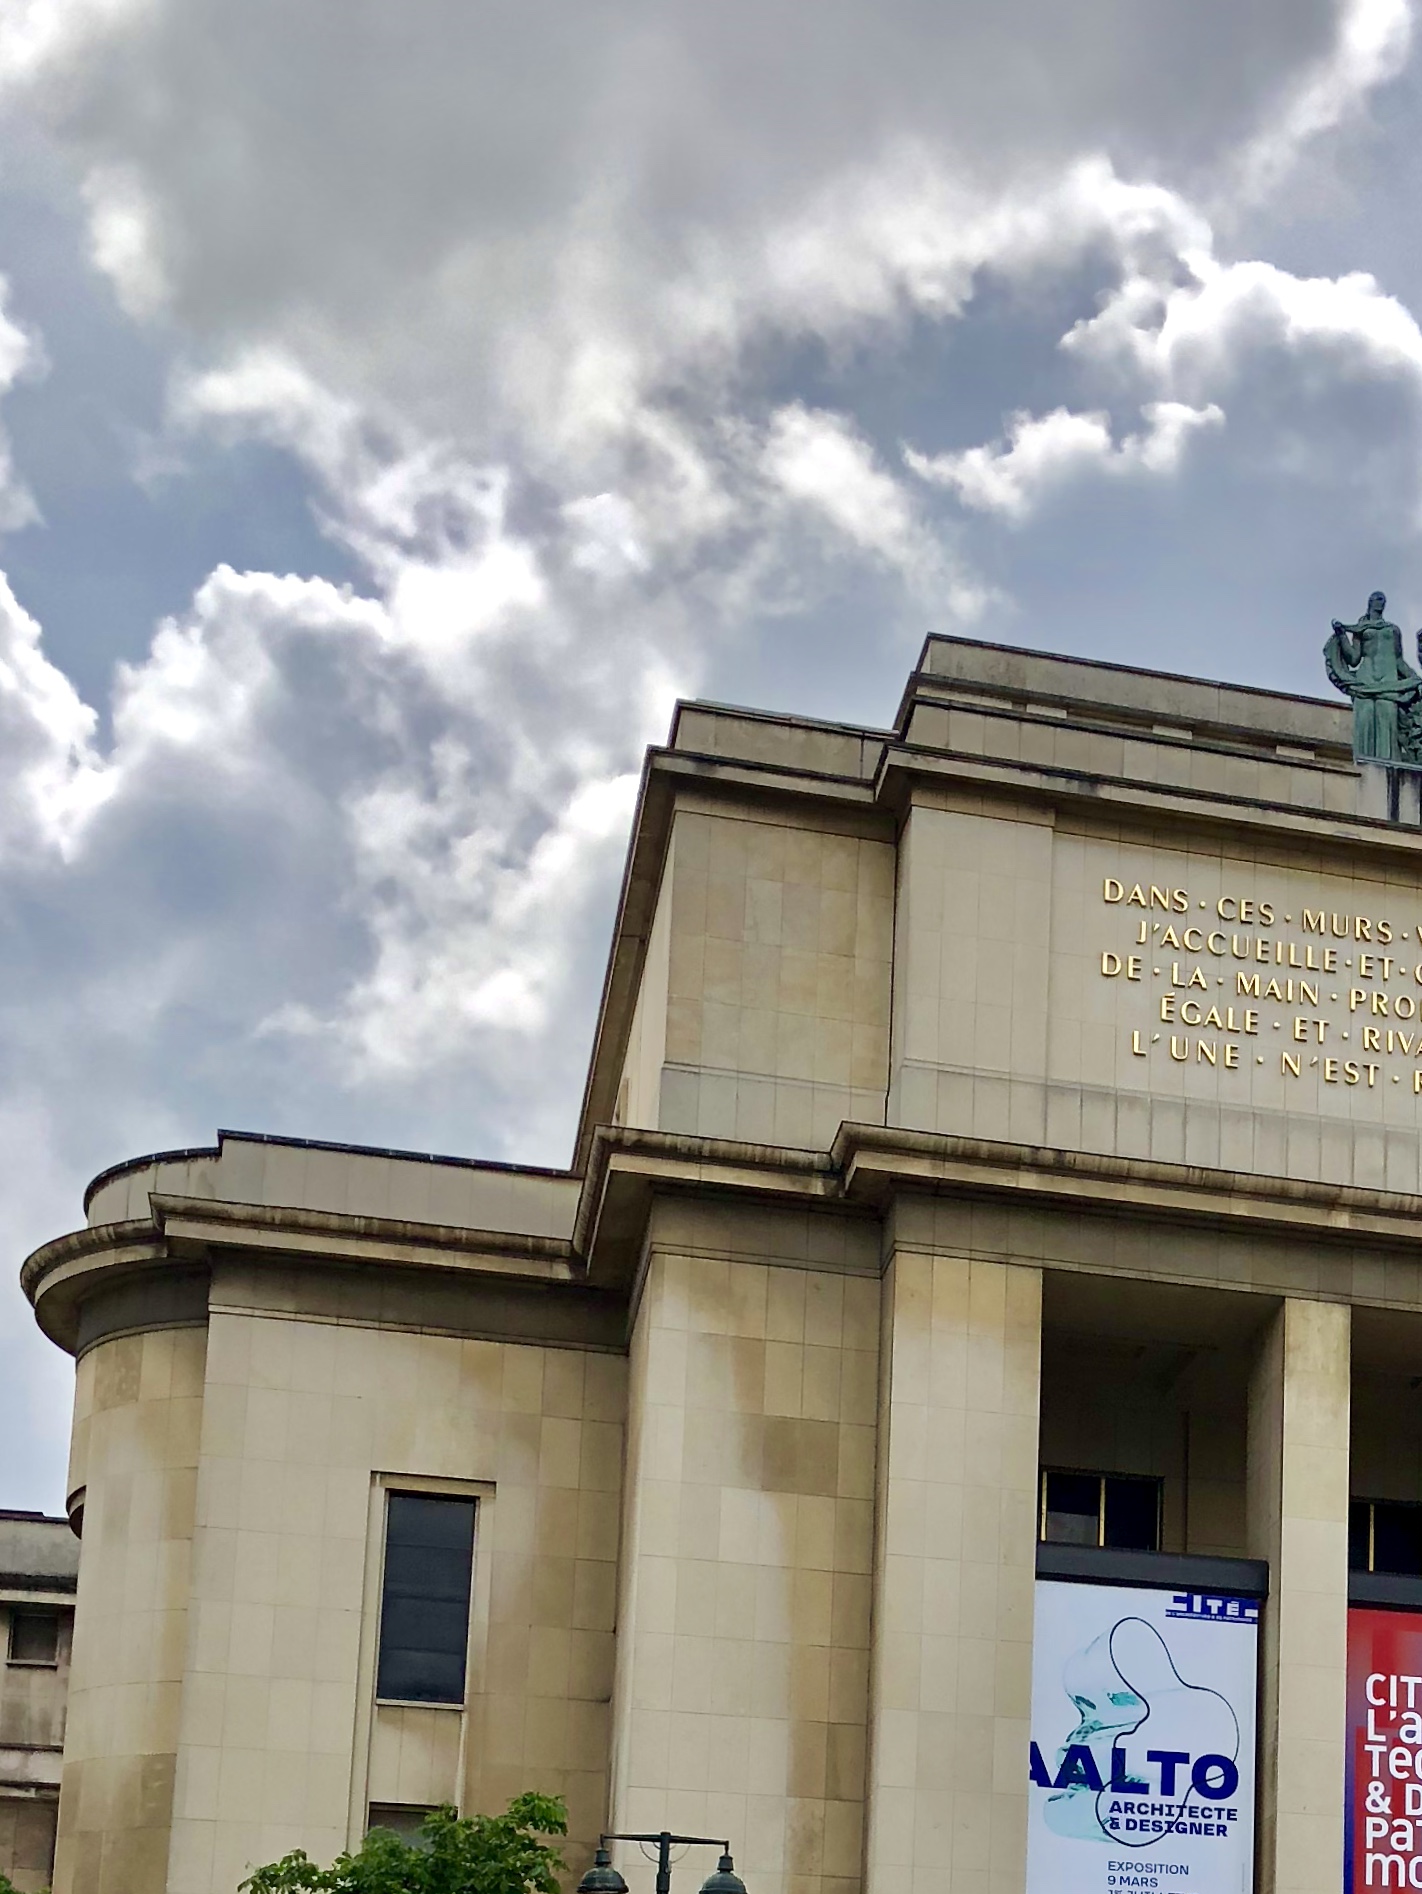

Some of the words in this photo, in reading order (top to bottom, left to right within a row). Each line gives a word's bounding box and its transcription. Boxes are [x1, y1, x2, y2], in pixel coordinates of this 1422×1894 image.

[1103, 878, 1189, 913] DANS
[1217, 897, 1275, 926] CES
[1302, 908, 1393, 944] MURS
[1136, 920, 1337, 973] J'ACCUEILLE
[1359, 953, 1394, 980] ET
[1100, 952, 1142, 980] DE
[1171, 962, 1207, 990] LA
[1236, 971, 1319, 1006] MAIN
[1160, 992, 1259, 1035] ÉGALE
[1293, 1016, 1330, 1043] ET
[1132, 1030, 1240, 1069] L'UNE
[1281, 1051, 1380, 1087] N'EST
[1109, 1800, 1238, 1821] ARCHITECTE
[1364, 1780, 1392, 1815] &
[1109, 1817, 1121, 1830] &
[1125, 1818, 1228, 1837] DESIGNER
[1107, 1861, 1189, 1875] EXPOSITION
[1107, 1875, 1116, 1886] 9
[1119, 1876, 1158, 1888] MARS
